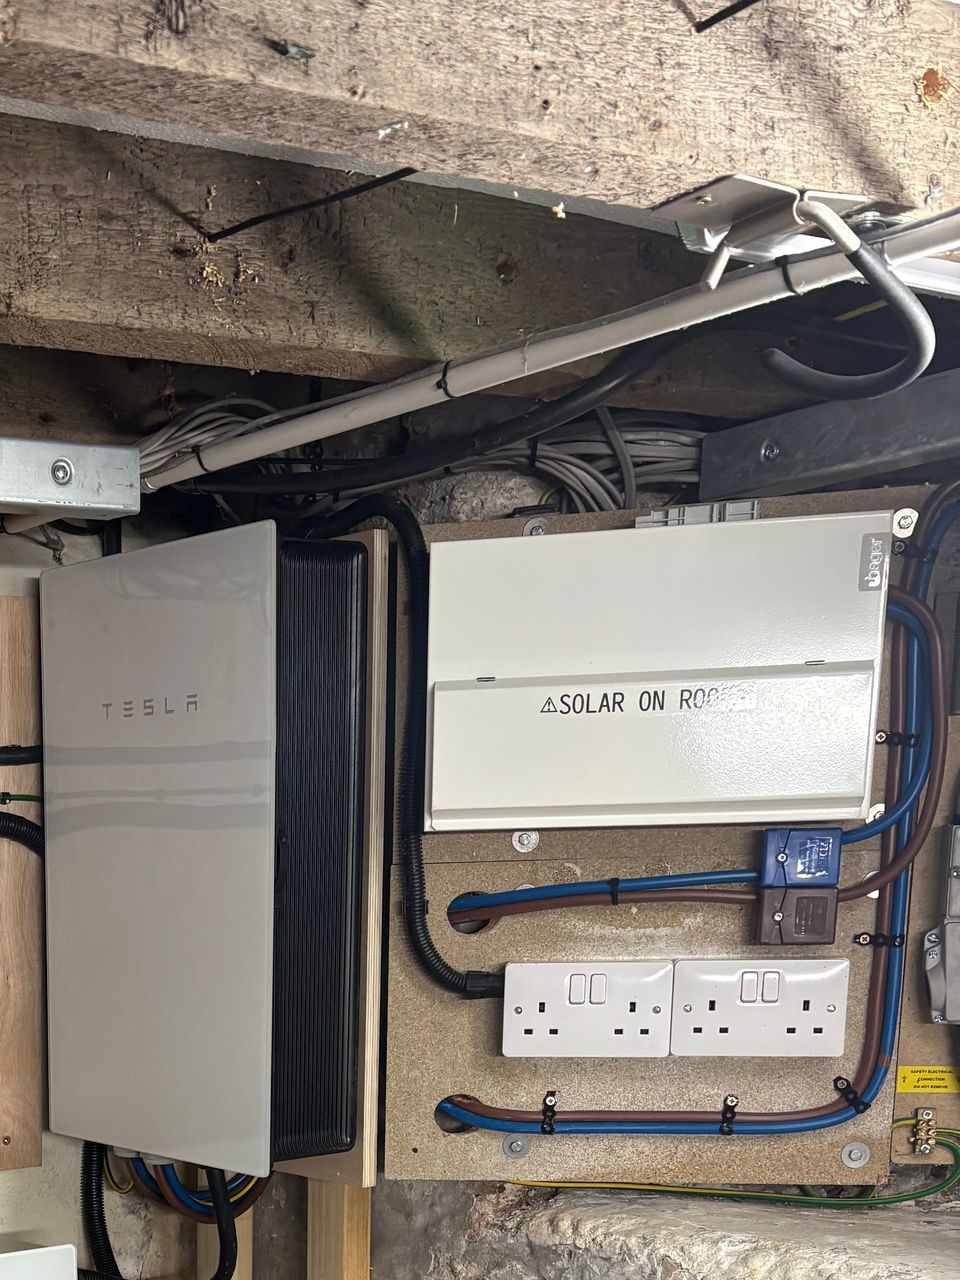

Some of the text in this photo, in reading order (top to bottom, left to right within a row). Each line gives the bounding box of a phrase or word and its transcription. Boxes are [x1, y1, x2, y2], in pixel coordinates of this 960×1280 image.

[102, 694, 198, 720] TESLA
[559, 692, 625, 714] SOLAR
[639, 690, 665, 712] ON
